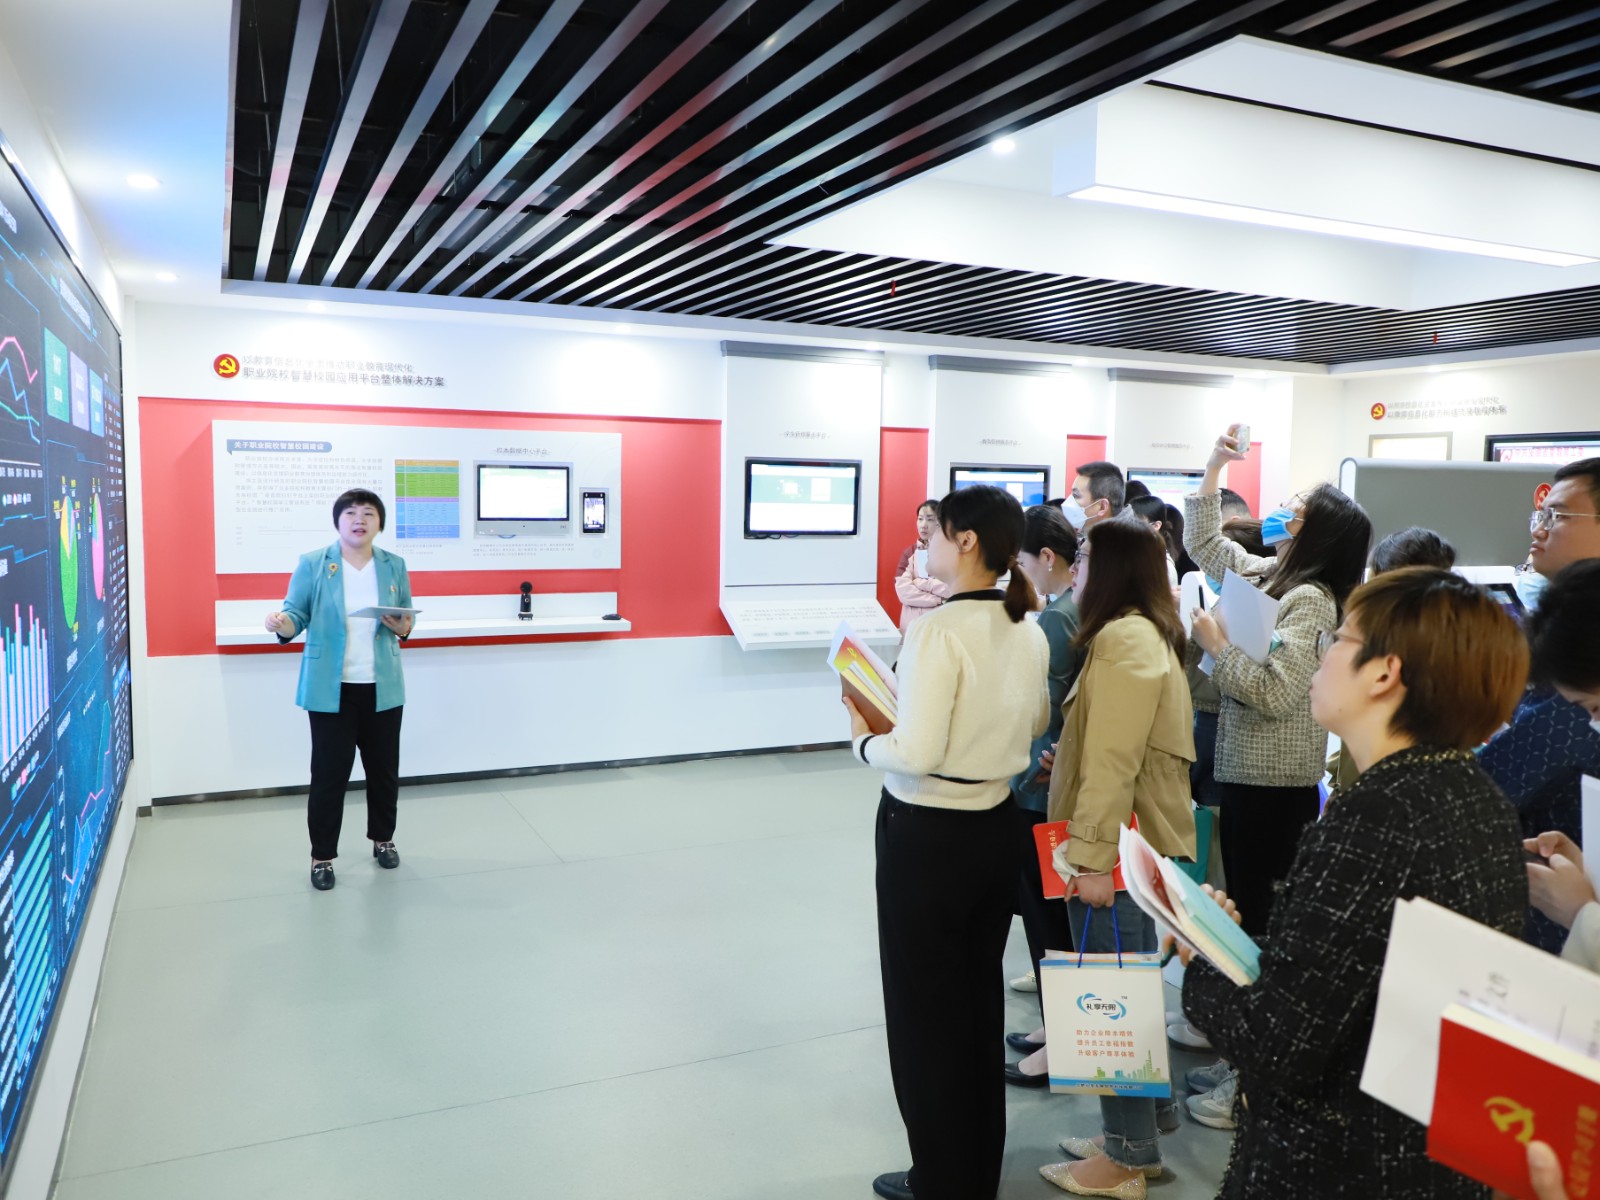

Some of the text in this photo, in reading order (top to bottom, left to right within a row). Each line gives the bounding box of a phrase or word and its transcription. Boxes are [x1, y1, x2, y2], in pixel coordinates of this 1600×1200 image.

[243, 367, 445, 387] 职业院校智慧校园应用平台整体解决方案
